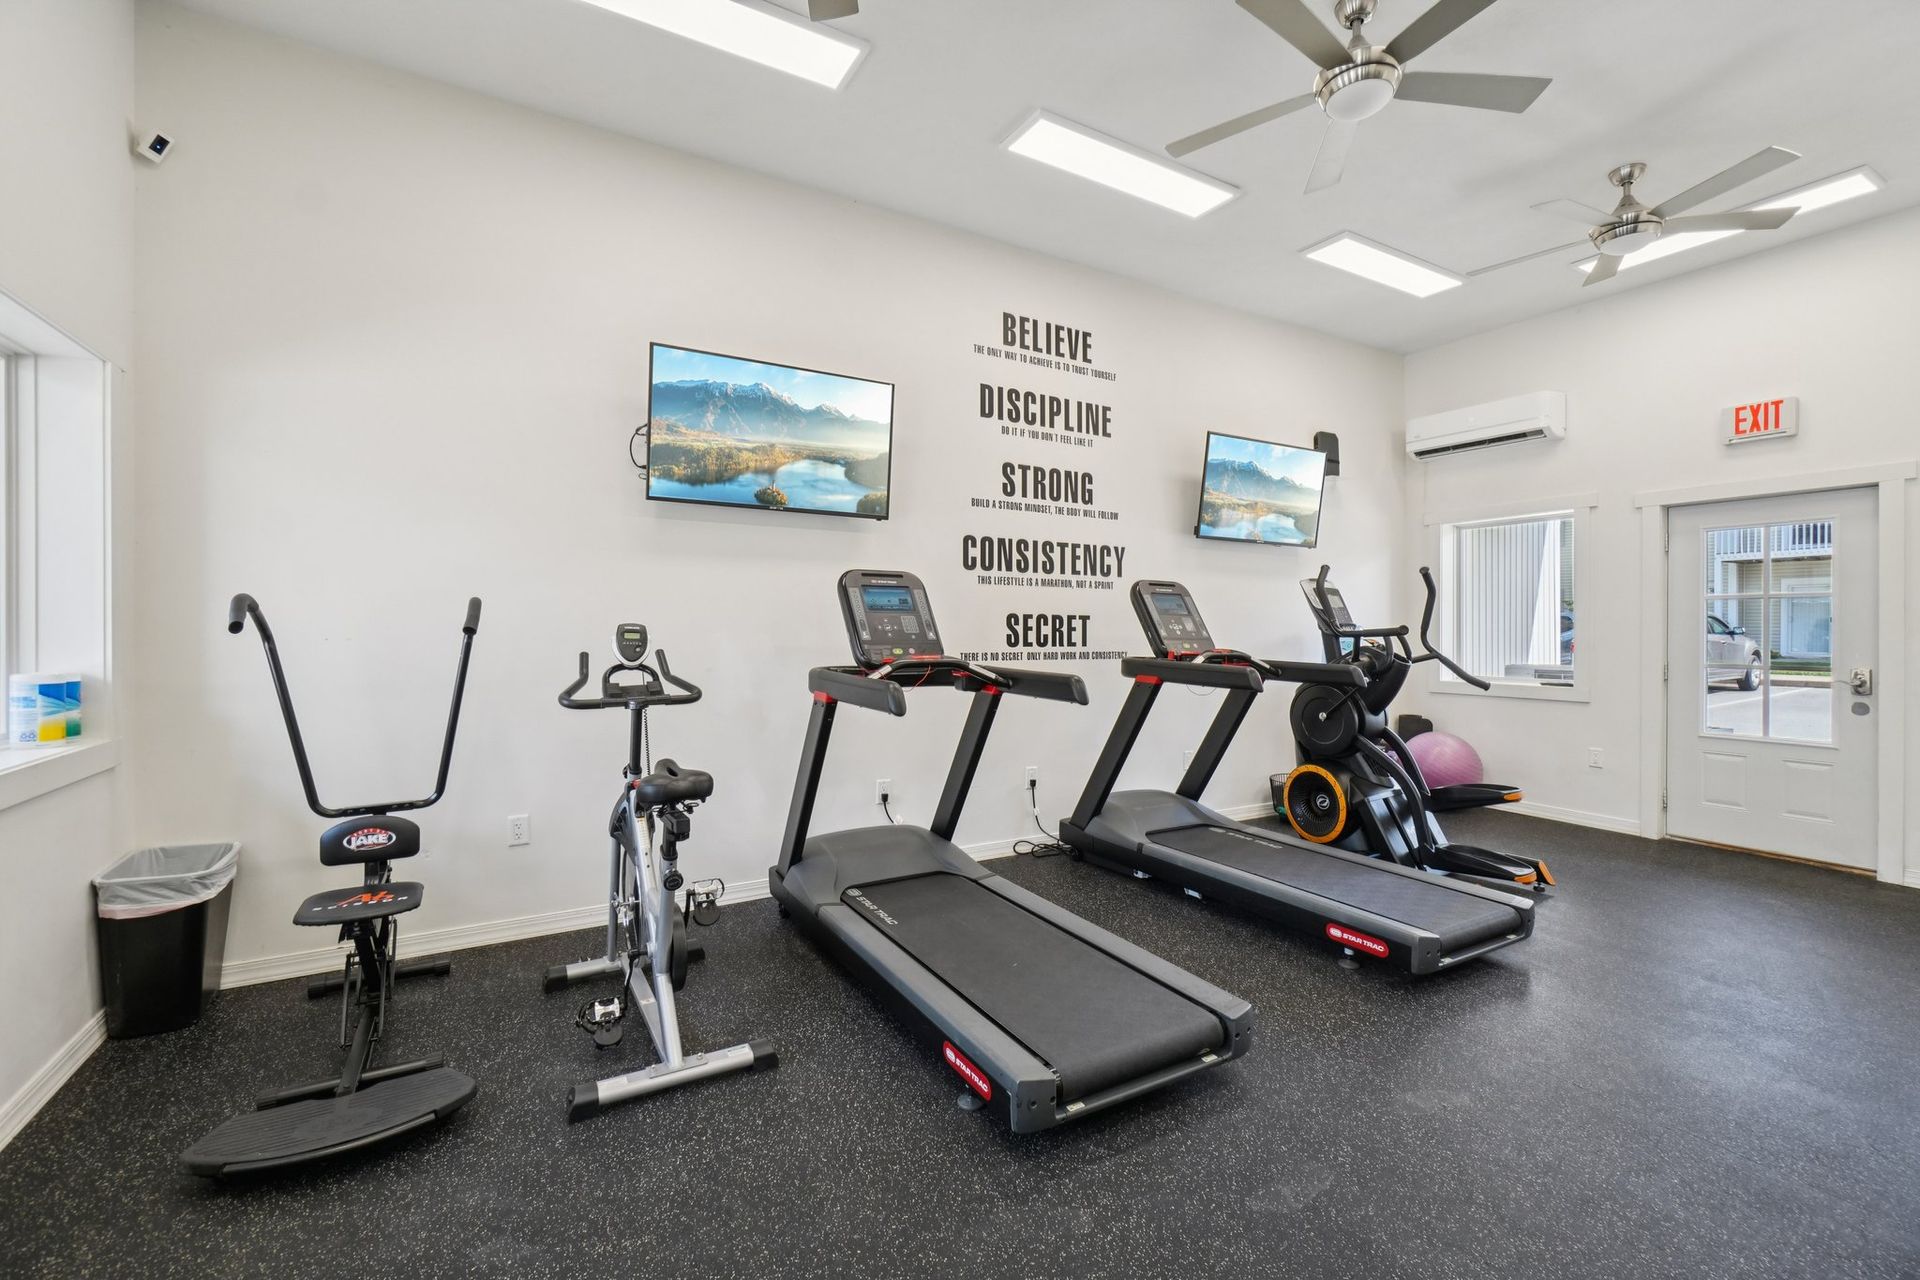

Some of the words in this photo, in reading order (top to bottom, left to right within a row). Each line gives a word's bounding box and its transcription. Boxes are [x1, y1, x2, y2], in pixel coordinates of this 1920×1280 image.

[1002, 311, 1092, 364] BELIEVE
[973, 344, 985, 355] THE
[986, 346, 1002, 358] ONLY
[1004, 350, 1018, 361] WAY
[1020, 353, 1028, 364] TO
[1029, 355, 1053, 369] ACHIEVE
[1054, 361, 1061, 370] IS
[1063, 362, 1070, 372] TO
[1071, 364, 1089, 376] TRUST
[1090, 368, 1117, 382] YOURSELF
[979, 383, 1112, 438] DISCIPLINE
[1734, 399, 1784, 435] EXIT
[1001, 425, 1010, 436] DO
[1011, 427, 1018, 437] IT
[1020, 428, 1026, 438] IF
[1028, 429, 1040, 440] YOU
[1060, 434, 1073, 445] FEEL
[1074, 436, 1086, 447] LIKE
[1087, 438, 1094, 448] IT
[1001, 461, 1093, 505] STRONG
[971, 497, 990, 508] BUILD
[991, 499, 997, 509] A
[998, 500, 1023, 511] STRONG
[1024, 503, 1053, 516] MINDSET,
[1054, 506, 1065, 516] THE
[1066, 507, 1081, 517] BODY
[1082, 509, 1096, 519] WILL
[1097, 510, 1119, 521] FOLLOW
[962, 534, 1126, 578] CONSISTENCY
[977, 575, 992, 585] THIS
[993, 576, 1025, 587] LIFESTYLE
[1026, 577, 1033, 587] IS
[1034, 578, 1039, 587] A
[1076, 579, 1088, 589] NOT
[1088, 580, 1093, 589] A
[1094, 580, 1114, 590] SPRINT
[1005, 612, 1091, 648] SECRET
[960, 652, 979, 661] THERE
[981, 652, 988, 661] IS
[990, 652, 1000, 661] NO
[1026, 651, 1042, 661] ONLY
[1043, 651, 1059, 661] HARD
[1060, 651, 1077, 660] WORK
[1078, 651, 1090, 660] AND
[1091, 651, 1128, 660] CONSISTENCY
[350, 833, 388, 850] JAKE
[1342, 932, 1362, 944] STAR
[1363, 939, 1385, 952] TRAC
[955, 1058, 971, 1077] STAR
[970, 1071, 988, 1093] TRAC
